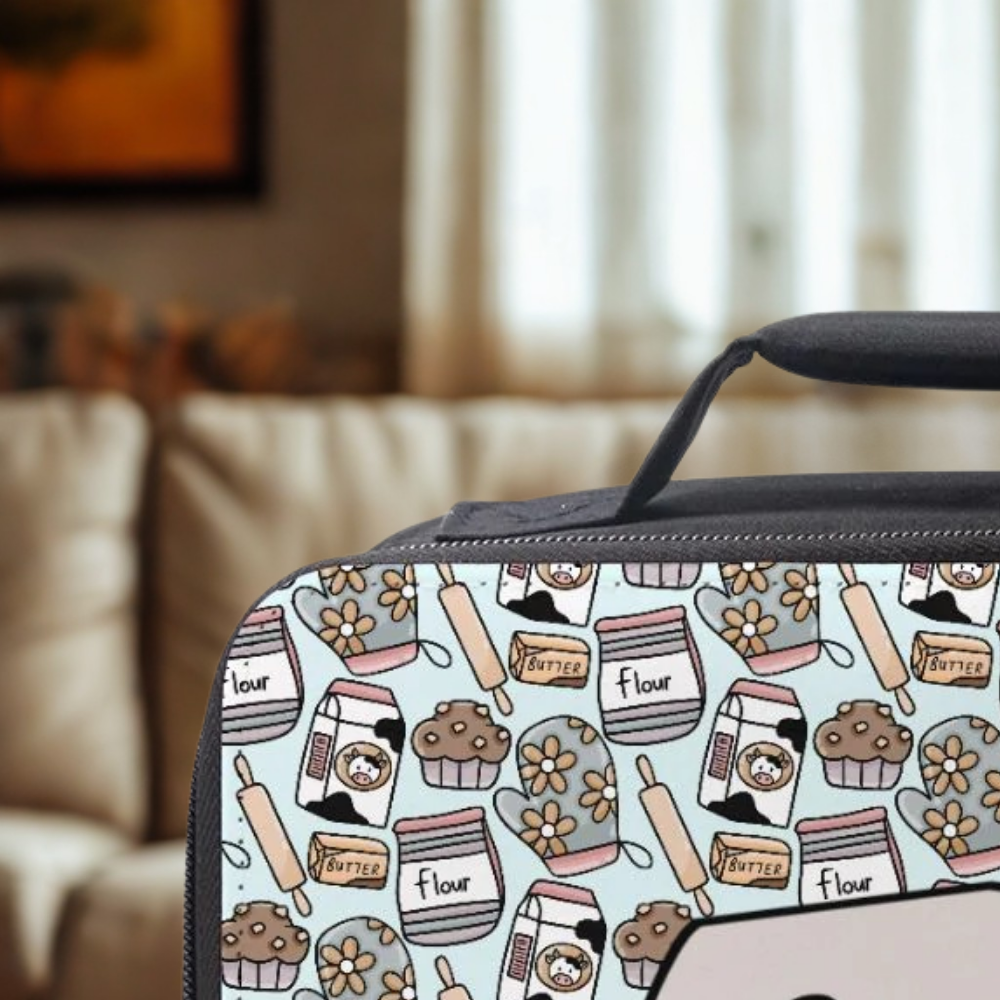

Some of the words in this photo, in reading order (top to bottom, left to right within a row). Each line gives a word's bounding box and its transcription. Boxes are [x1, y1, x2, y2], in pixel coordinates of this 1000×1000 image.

[527, 656, 582, 676] BUTTER
[929, 656, 984, 676] BUTTER
[615, 667, 672, 699] flour
[326, 857, 381, 877] BUTTER
[728, 857, 783, 877] BUTTER
[414, 868, 471, 900] flour
[816, 868, 873, 900] flour
